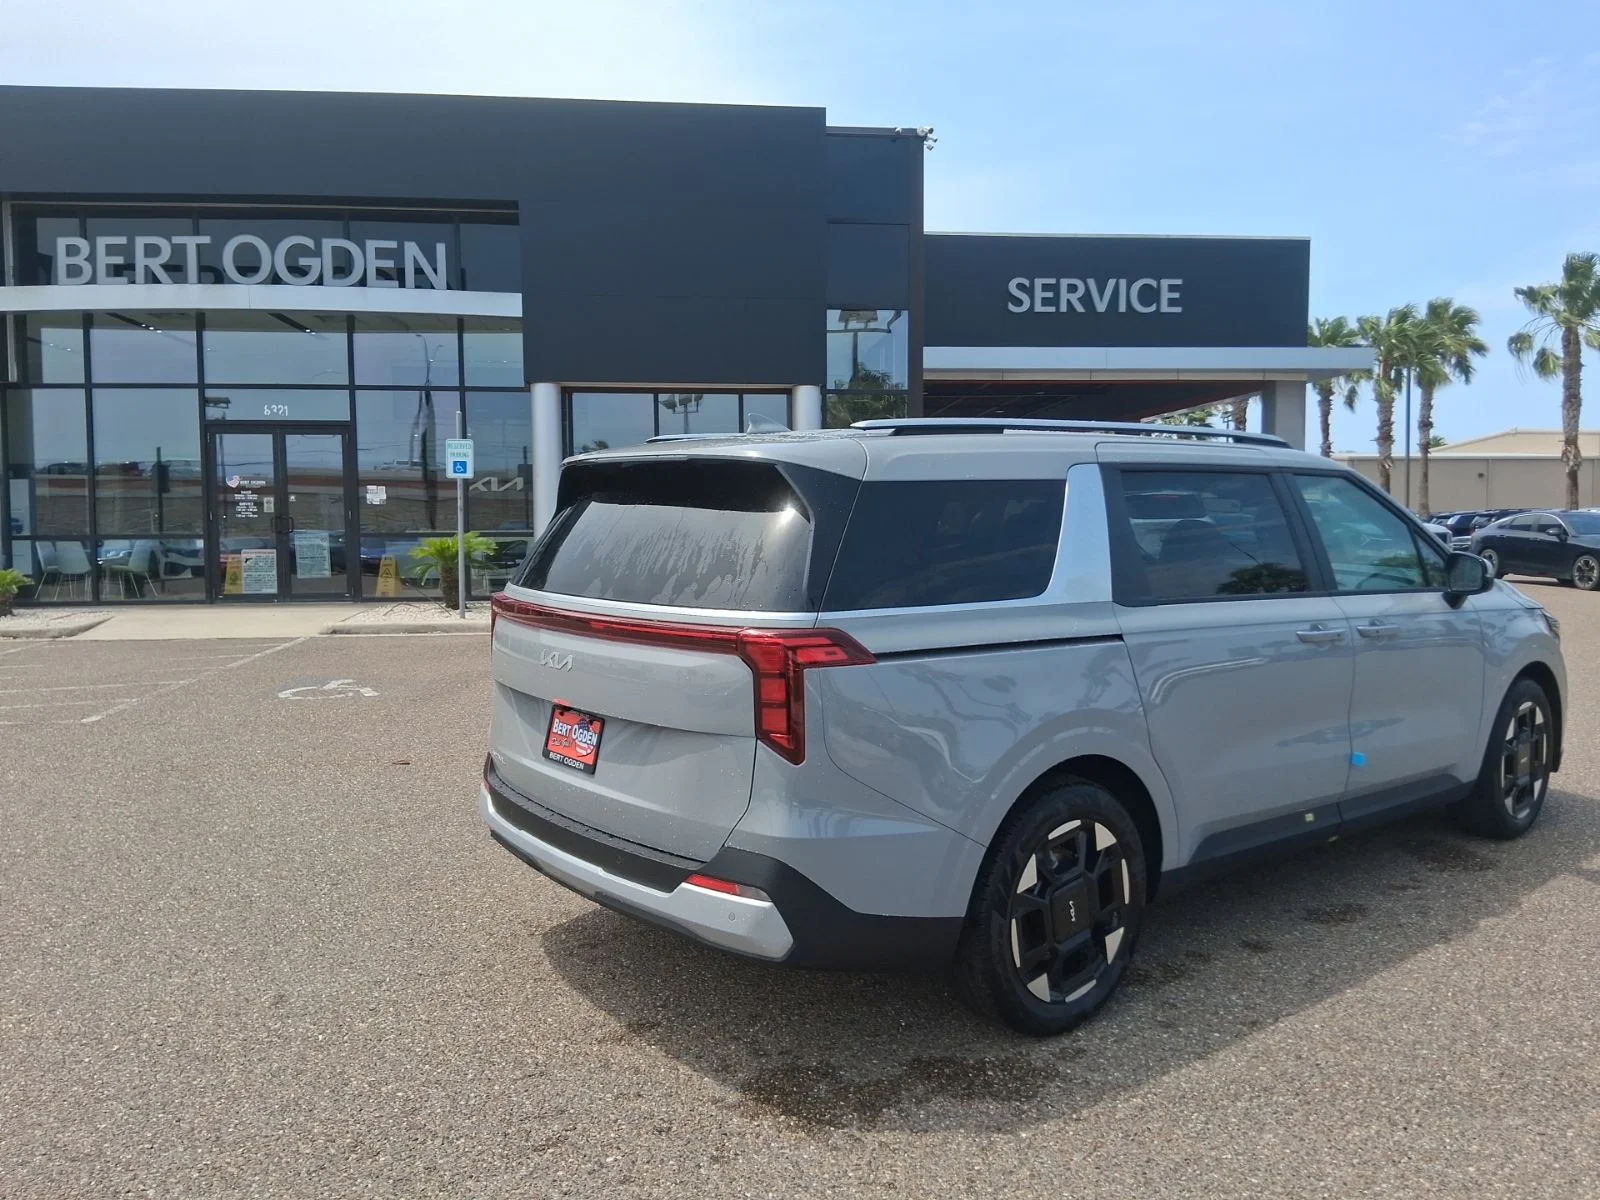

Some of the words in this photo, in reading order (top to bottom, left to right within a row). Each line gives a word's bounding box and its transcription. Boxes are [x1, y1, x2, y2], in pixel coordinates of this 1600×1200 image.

[56, 235, 212, 286] BERT
[222, 234, 448, 290] OGDEN
[1007, 277, 1183, 313] SERVICE
[553, 718, 571, 737] BERT
[571, 724, 598, 746] OGDEN
[548, 751, 564, 763] BERT
[563, 757, 585, 771] OGDEN
